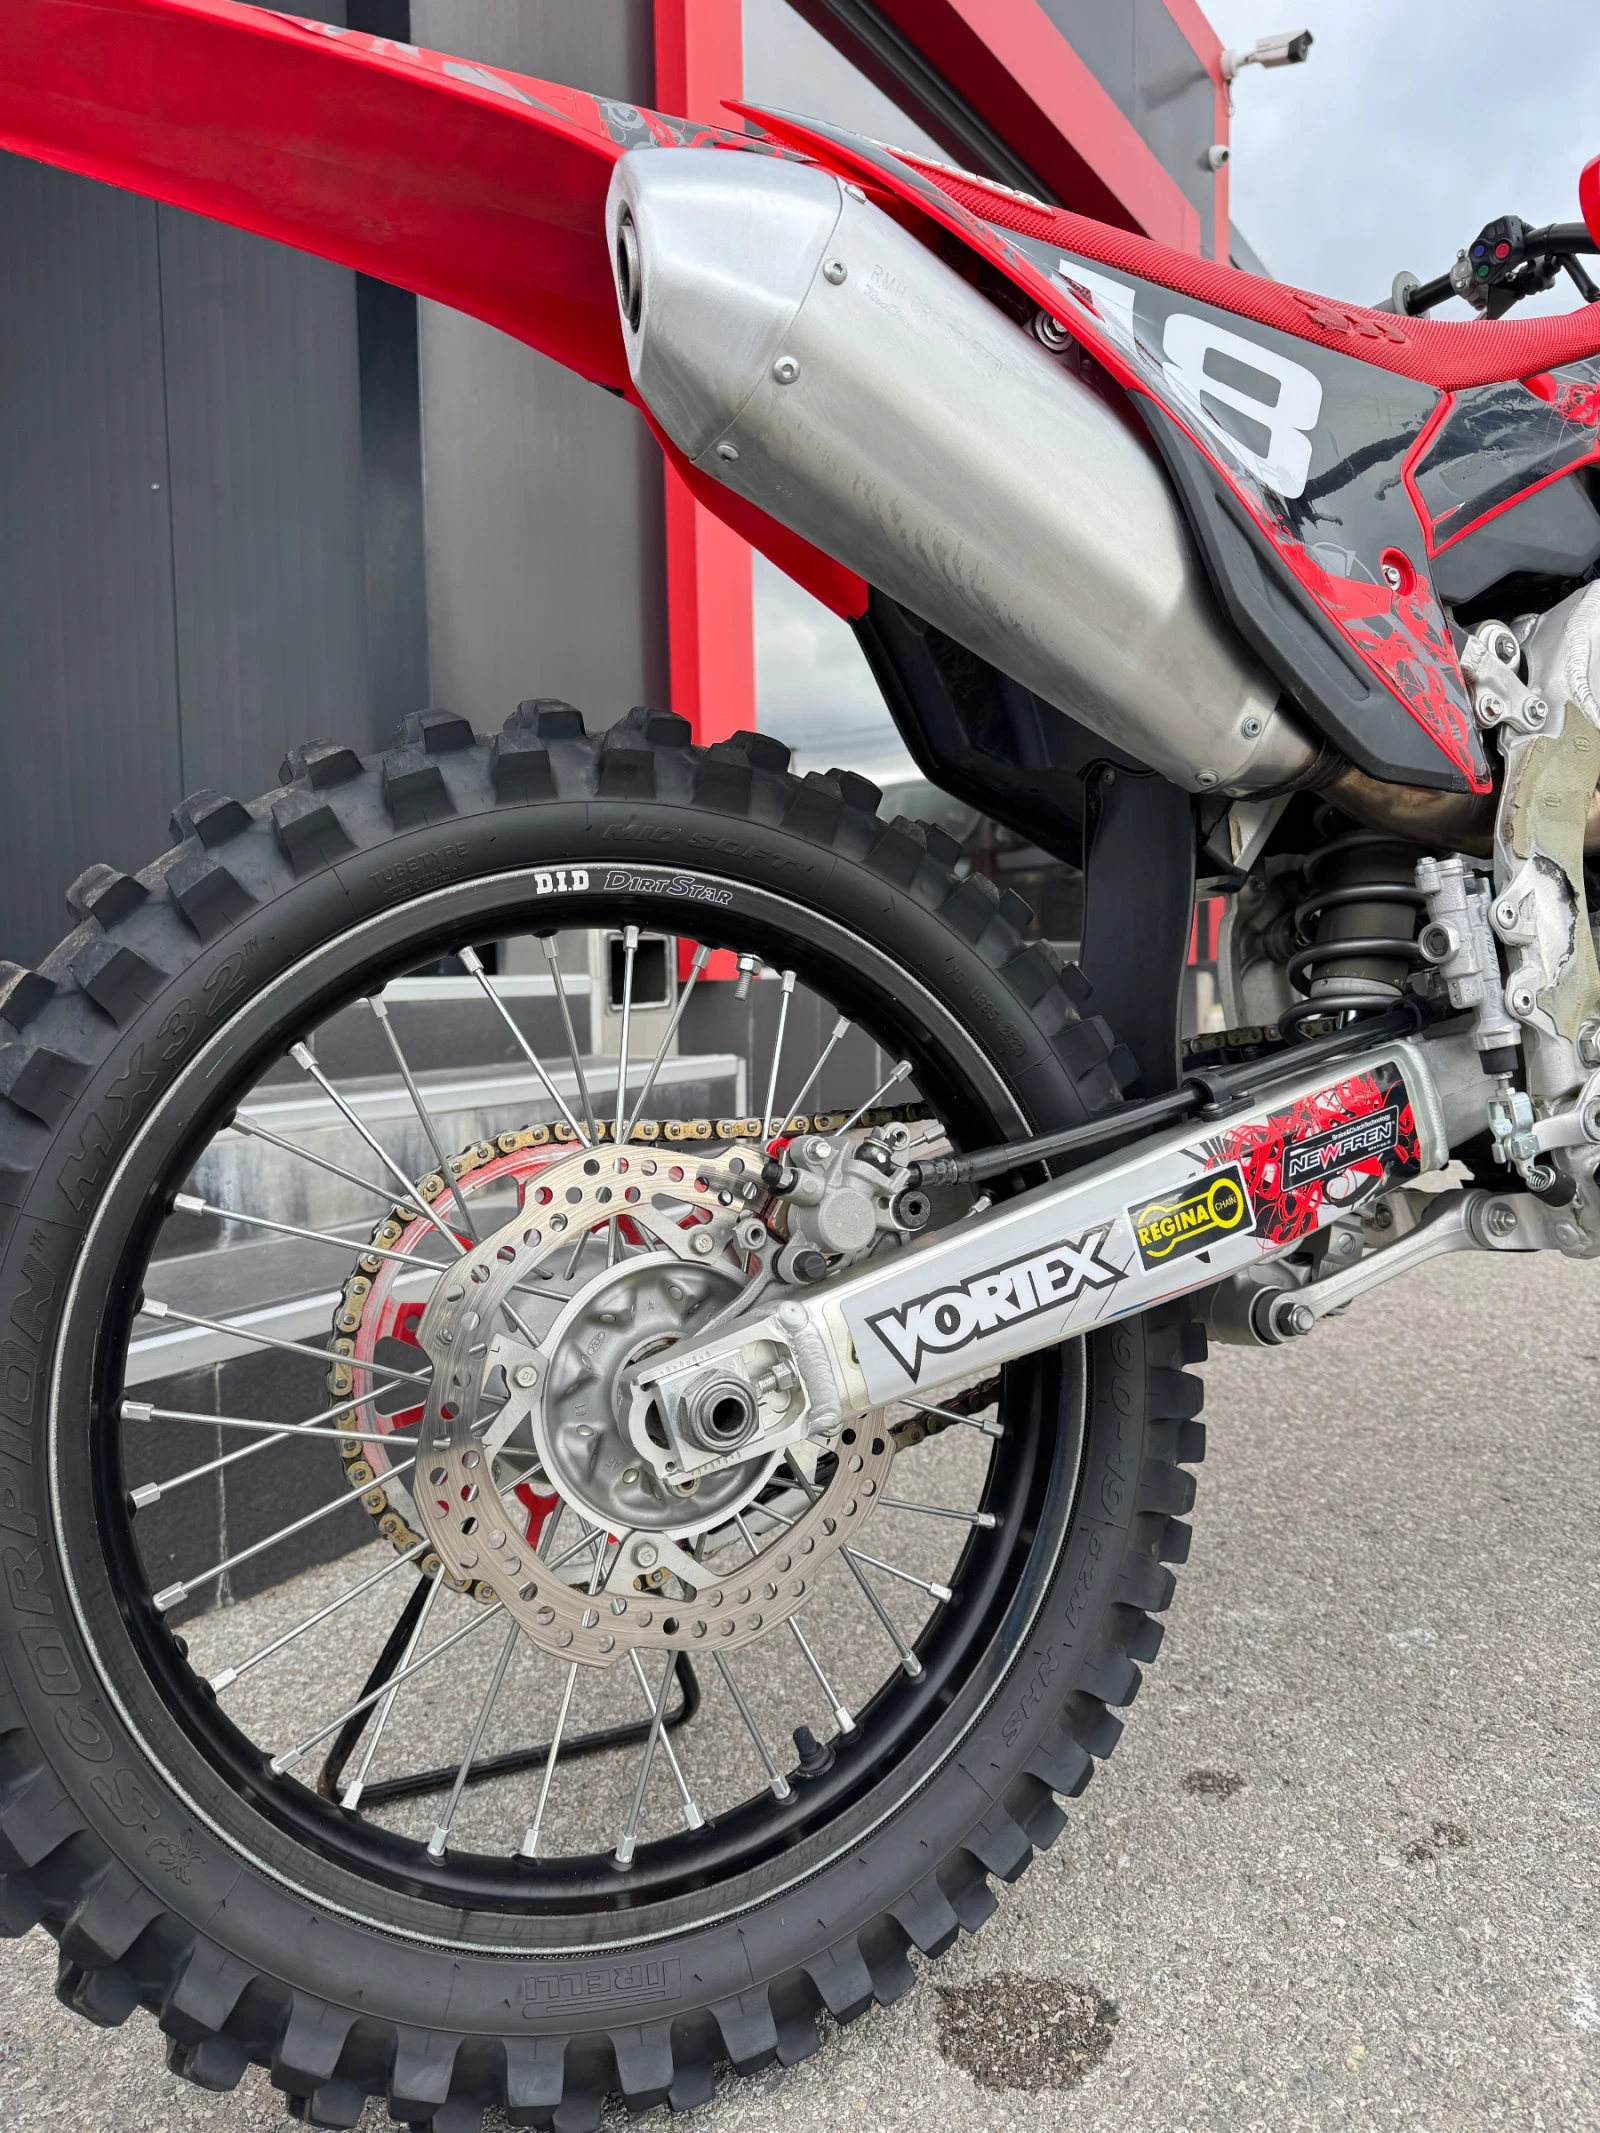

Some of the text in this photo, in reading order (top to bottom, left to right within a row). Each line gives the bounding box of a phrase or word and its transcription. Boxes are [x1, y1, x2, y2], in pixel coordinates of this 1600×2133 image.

[368, 840, 469, 888] TUBETYPE
[602, 824, 798, 869] MID SOFT
[1289, 1121, 1393, 1177] NEWFREN
[1137, 1204, 1211, 1247] REGINA
[1214, 1196, 1237, 1211] CHAIN
[864, 1219, 1129, 1384] VORTEX
[1002, 1646, 1060, 1748] NHS
[522, 1958, 683, 2020] PIRELLI
